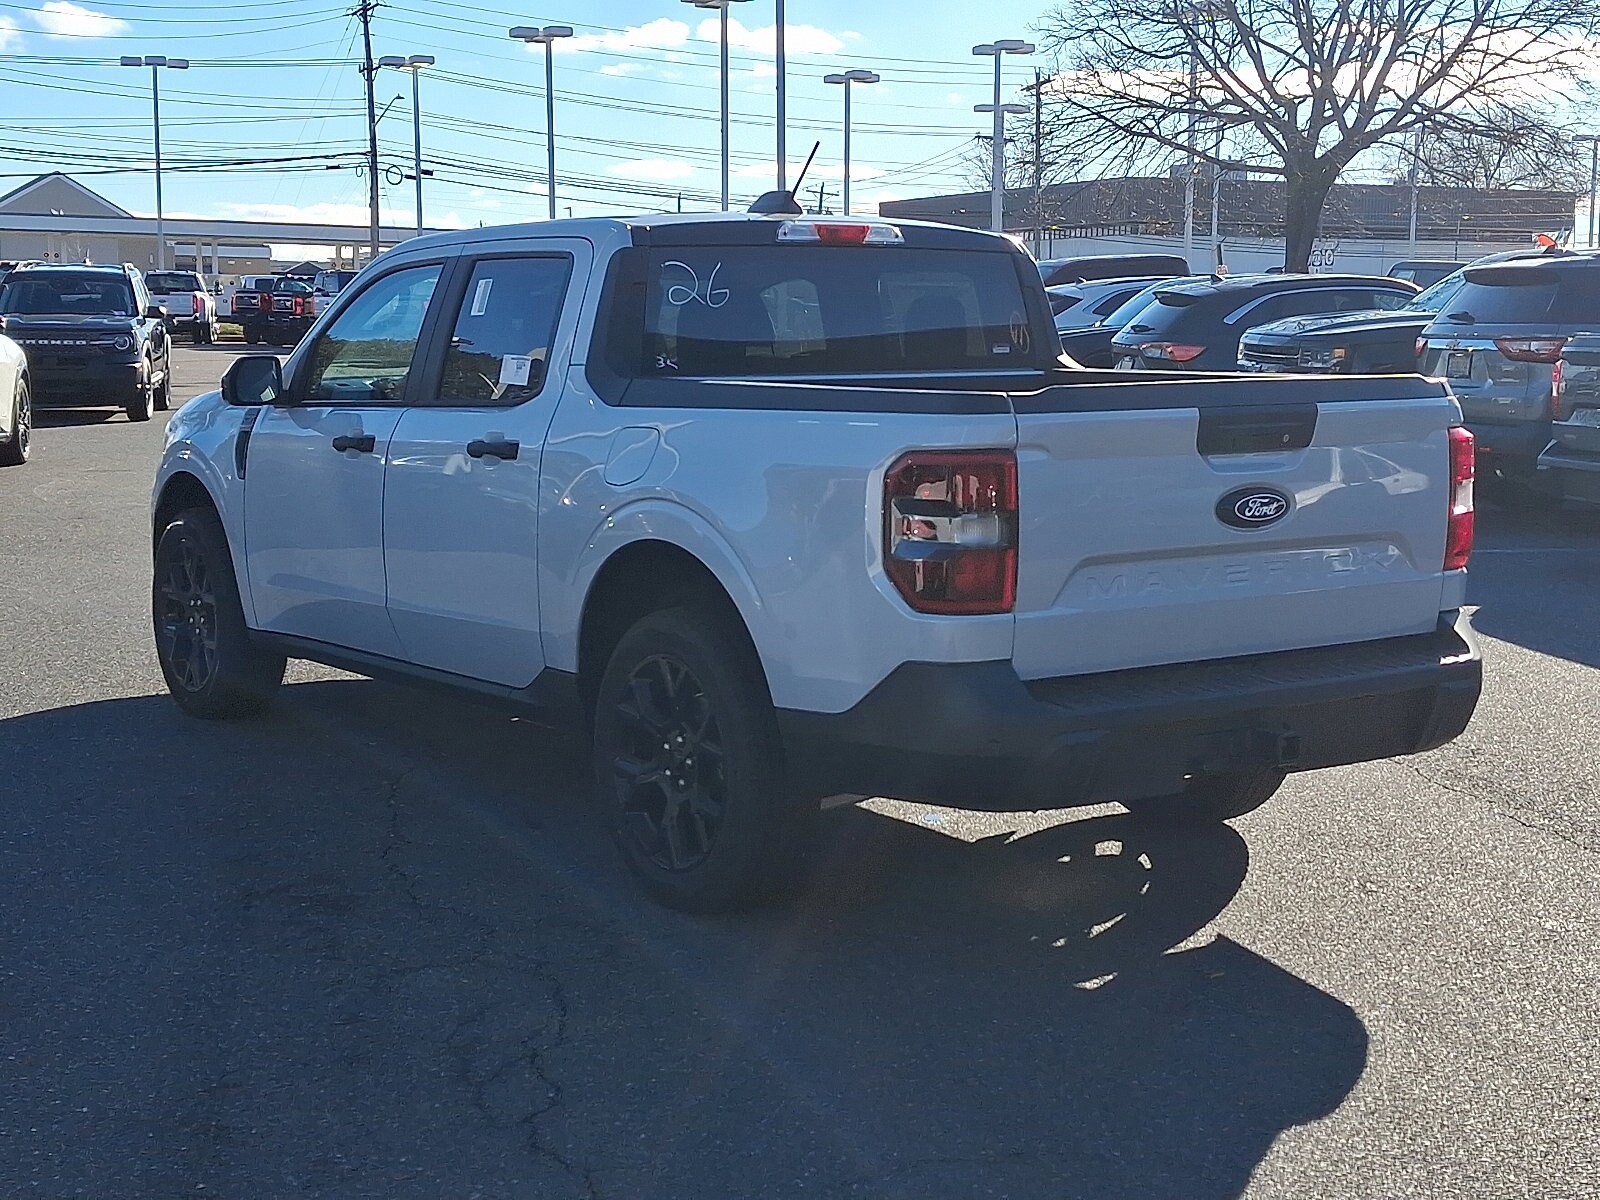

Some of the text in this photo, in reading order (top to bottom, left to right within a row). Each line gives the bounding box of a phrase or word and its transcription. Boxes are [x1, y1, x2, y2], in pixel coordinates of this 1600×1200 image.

[660, 261, 730, 308] 26
[1244, 498, 1285, 517] Ford
[1086, 546, 1402, 599] MAVERICK
